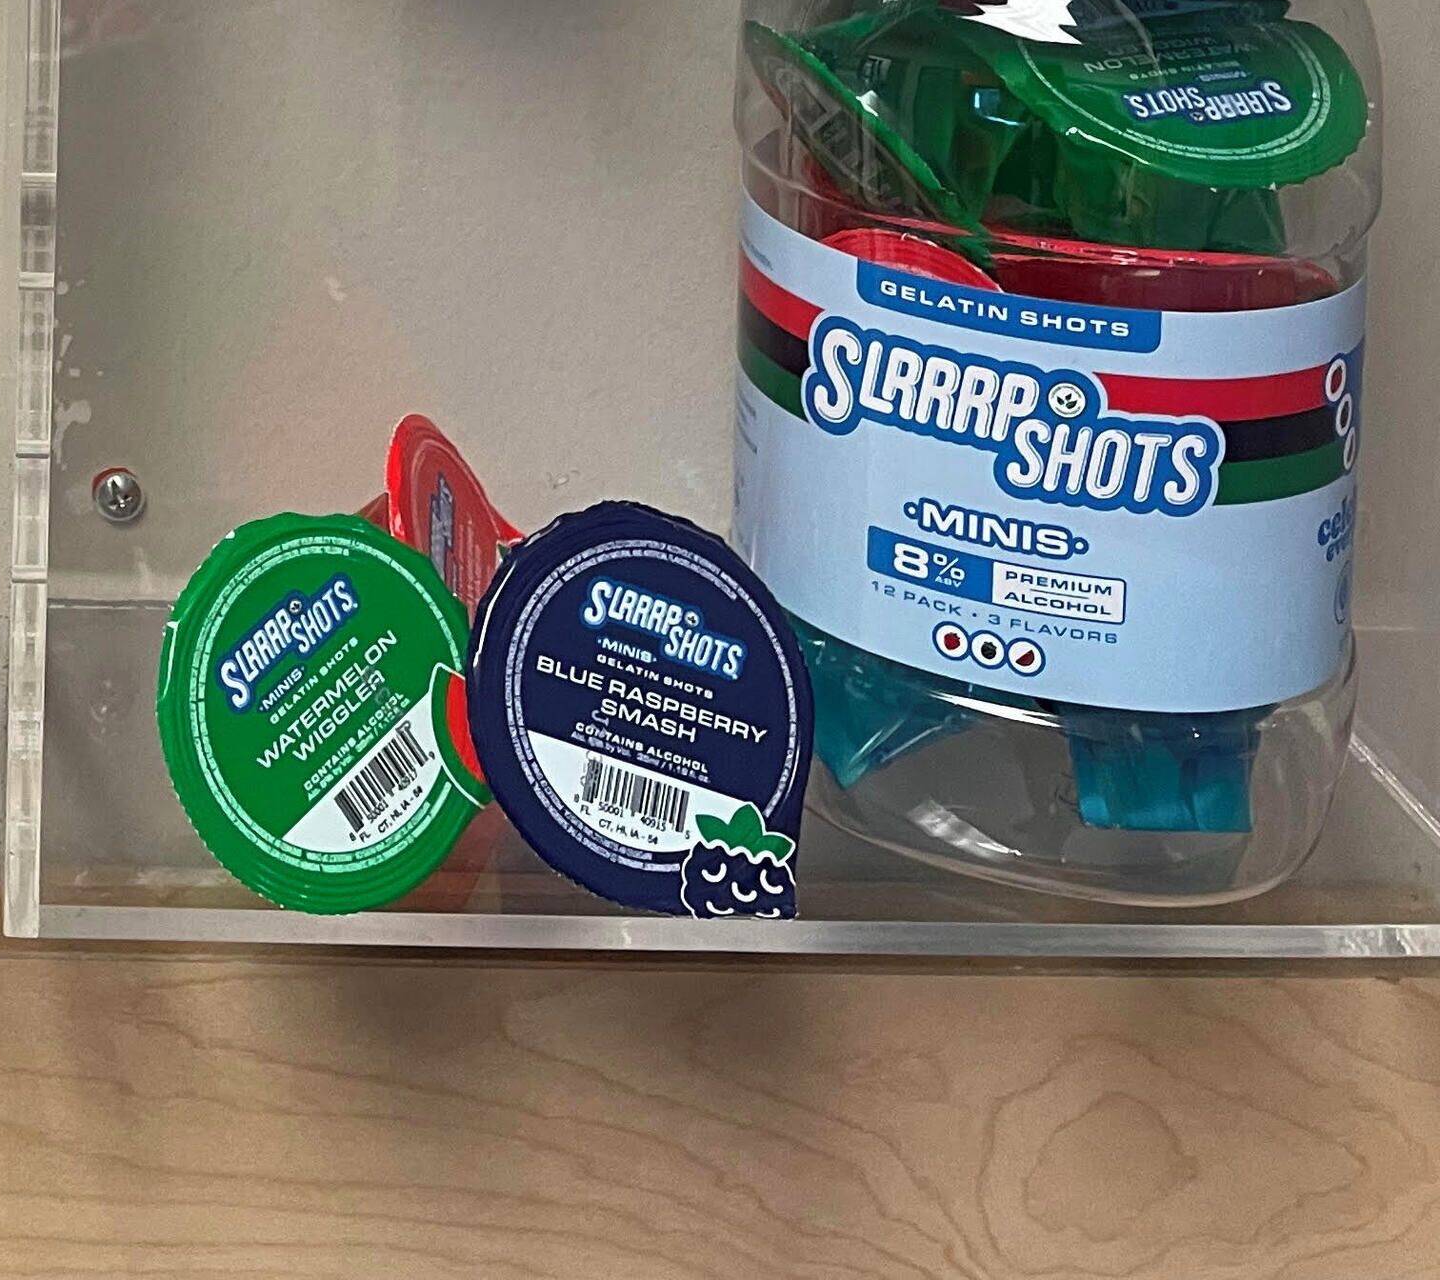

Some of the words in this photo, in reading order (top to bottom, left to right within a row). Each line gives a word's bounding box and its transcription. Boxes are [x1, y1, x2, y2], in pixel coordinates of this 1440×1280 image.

[879, 278, 1009, 321] GELATIN
[1020, 310, 1131, 338] SHOTS
[813, 327, 1040, 443] SLRRRP
[1005, 418, 1207, 507] SHOTS
[920, 504, 1071, 556] MINIS
[893, 541, 966, 582] 8%
[934, 576, 963, 588] ABV
[1004, 569, 1113, 596] PREMIUM
[289, 579, 355, 654] SHOTS
[871, 579, 897, 597] 12
[902, 588, 963, 618] PACK
[987, 612, 1002, 626] 3
[1009, 617, 1120, 646] FLAVORS
[1003, 592, 1112, 618] ALCOHOL
[601, 637, 653, 663] MINIS
[663, 626, 743, 676] SHOTS
[256, 629, 398, 770] WATERMELON
[262, 669, 304, 710] MINIS
[269, 674, 320, 725] GELATIN
[320, 636, 359, 677] SHOTS
[536, 655, 604, 691] BLUE
[608, 679, 768, 744] RASPBERRY
[596, 653, 660, 682] GELATIN
[663, 676, 714, 700] SHOTS
[292, 669, 386, 762] WIGGLER
[600, 698, 697, 743] SMASH
[303, 737, 357, 792] CONTAINS
[575, 721, 644, 752] CONTAINS
[646, 746, 709, 774] ALCOHOL
[579, 805, 592, 816] FL
